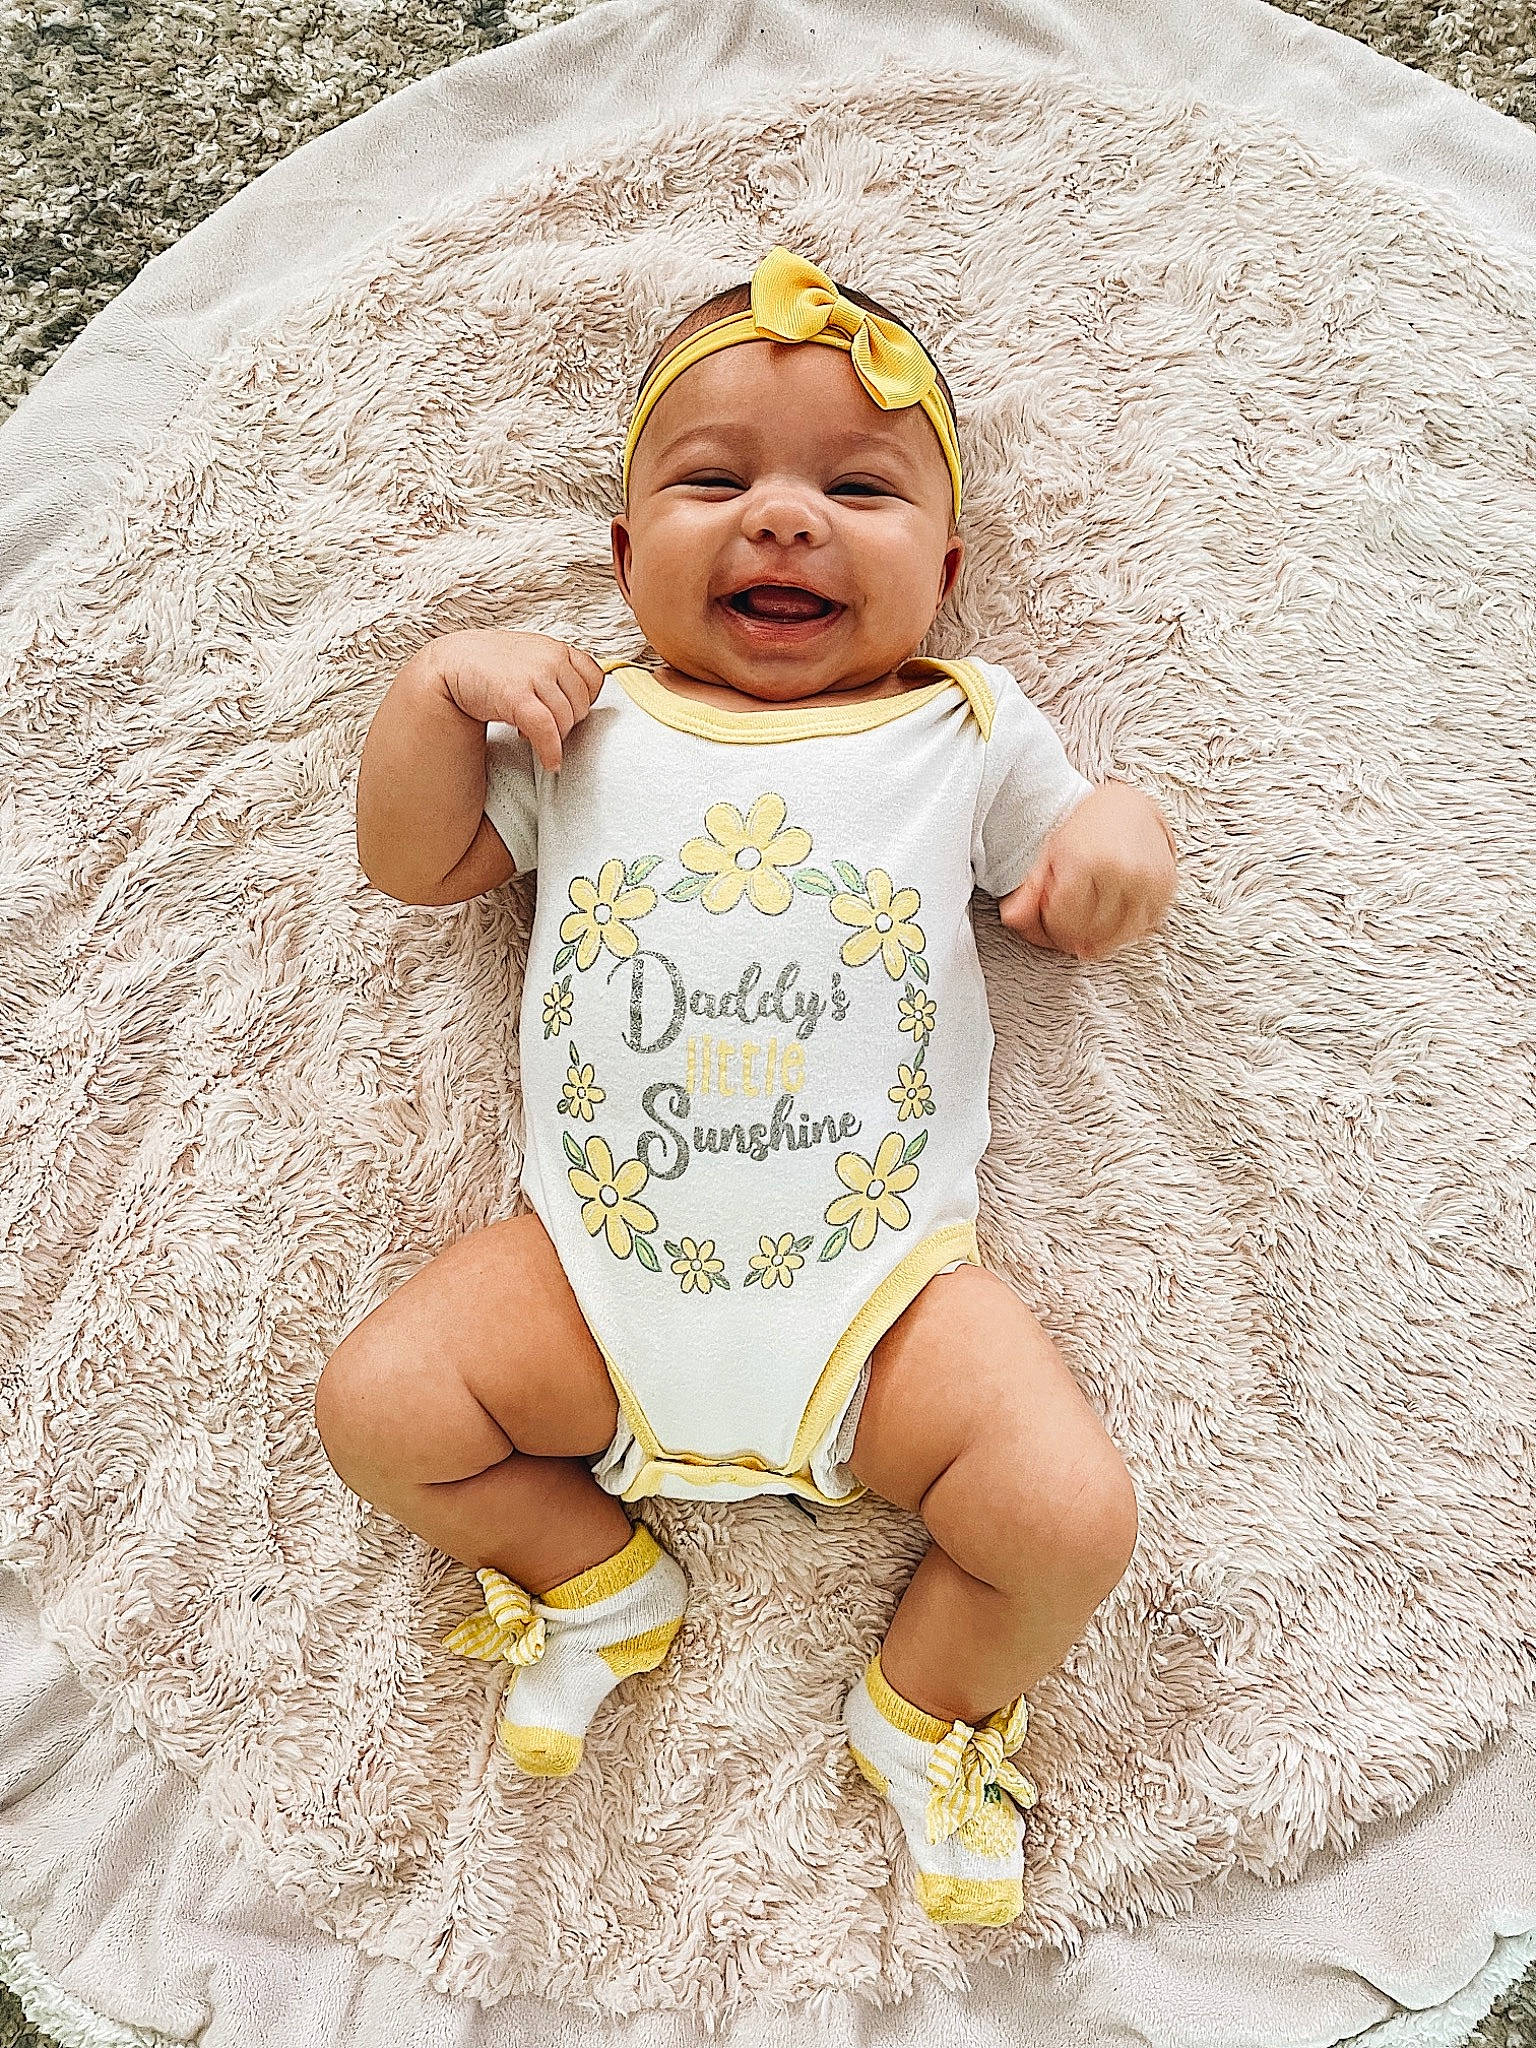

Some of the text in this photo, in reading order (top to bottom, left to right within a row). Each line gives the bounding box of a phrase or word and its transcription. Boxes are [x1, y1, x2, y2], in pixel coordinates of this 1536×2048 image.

[606, 950, 850, 1053] Daddy's
[686, 1034, 806, 1097] little
[637, 1082, 862, 1180] Sunshine
